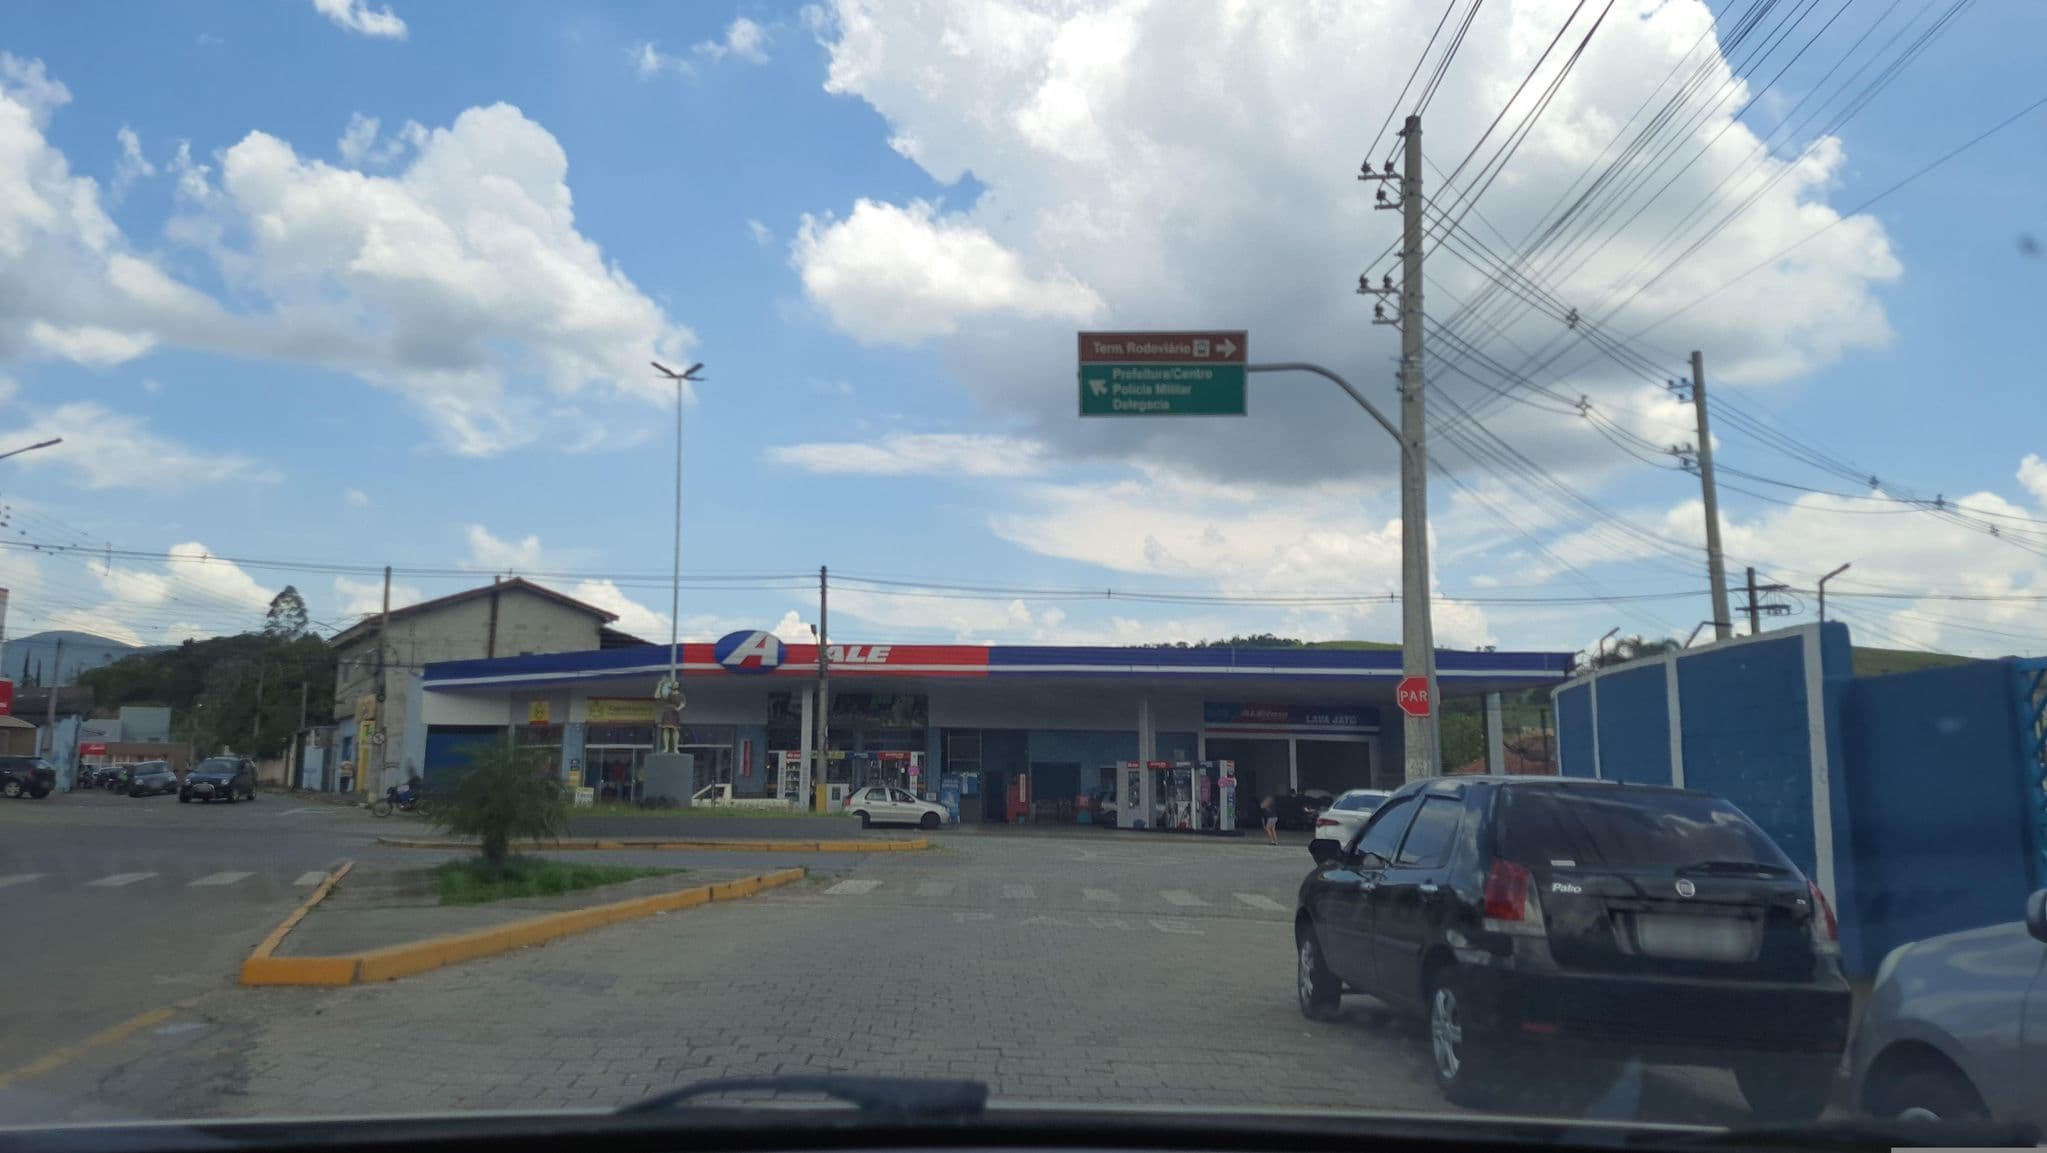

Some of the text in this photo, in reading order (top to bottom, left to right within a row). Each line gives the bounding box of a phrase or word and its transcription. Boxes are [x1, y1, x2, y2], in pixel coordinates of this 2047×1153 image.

[1155, 383, 1192, 395] Militar
[1112, 398, 1170, 411] Delegacia
[814, 645, 892, 663] ALE
[1400, 689, 1429, 703] PAR
[1552, 882, 1582, 894] Palio
[951, 913, 1206, 934] PARE
